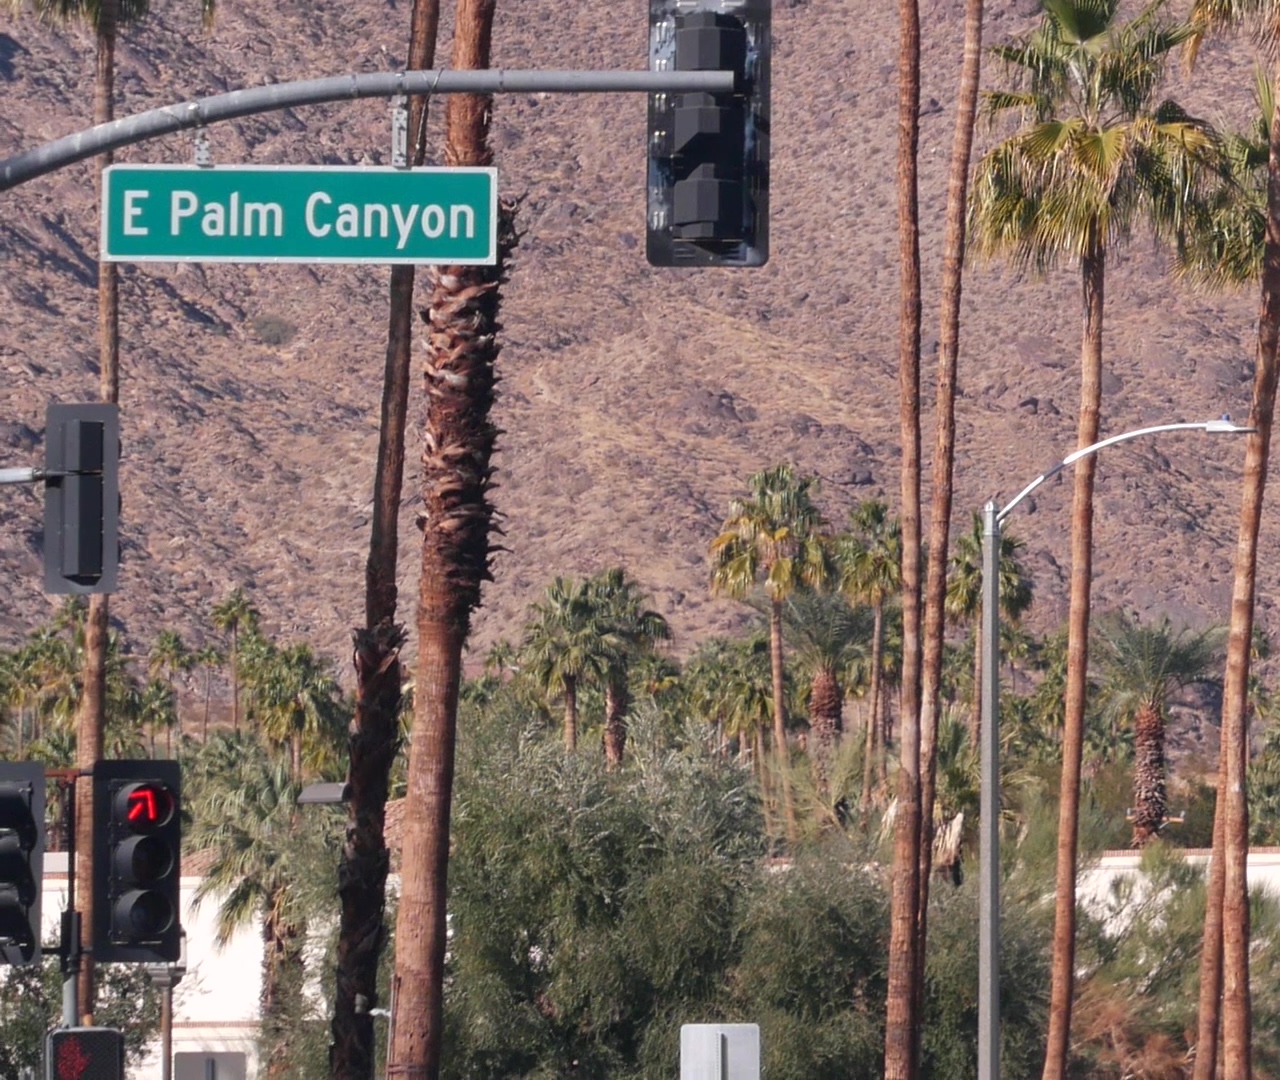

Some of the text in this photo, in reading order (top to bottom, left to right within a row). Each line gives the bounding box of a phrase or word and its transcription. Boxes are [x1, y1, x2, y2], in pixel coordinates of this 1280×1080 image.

[123, 190, 474, 250] E Palm Canyon
